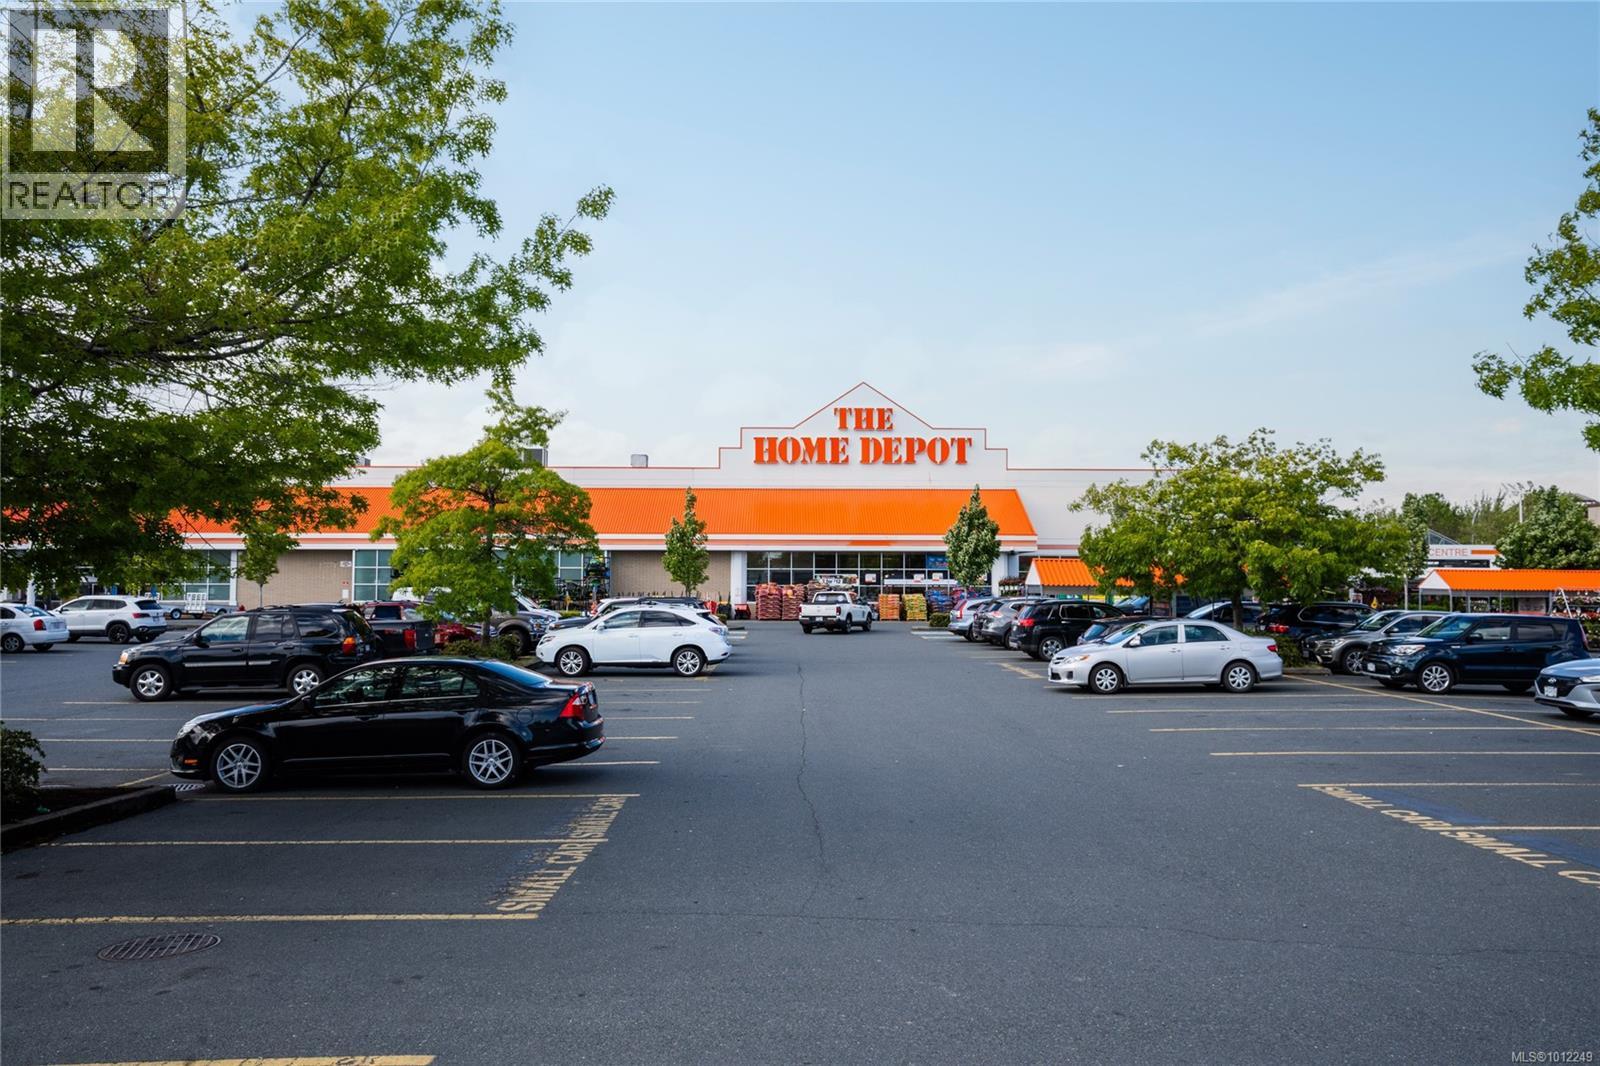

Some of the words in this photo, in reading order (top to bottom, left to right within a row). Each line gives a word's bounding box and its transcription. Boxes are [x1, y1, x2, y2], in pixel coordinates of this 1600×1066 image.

[833, 407, 894, 431] THE
[753, 436, 849, 465] HOME
[859, 436, 973, 465] DEPOT
[1429, 547, 1469, 557] CENTRE
[1439, 831, 1568, 868] SMALL
[496, 866, 577, 911] SMALL
[545, 843, 599, 864] CAR
